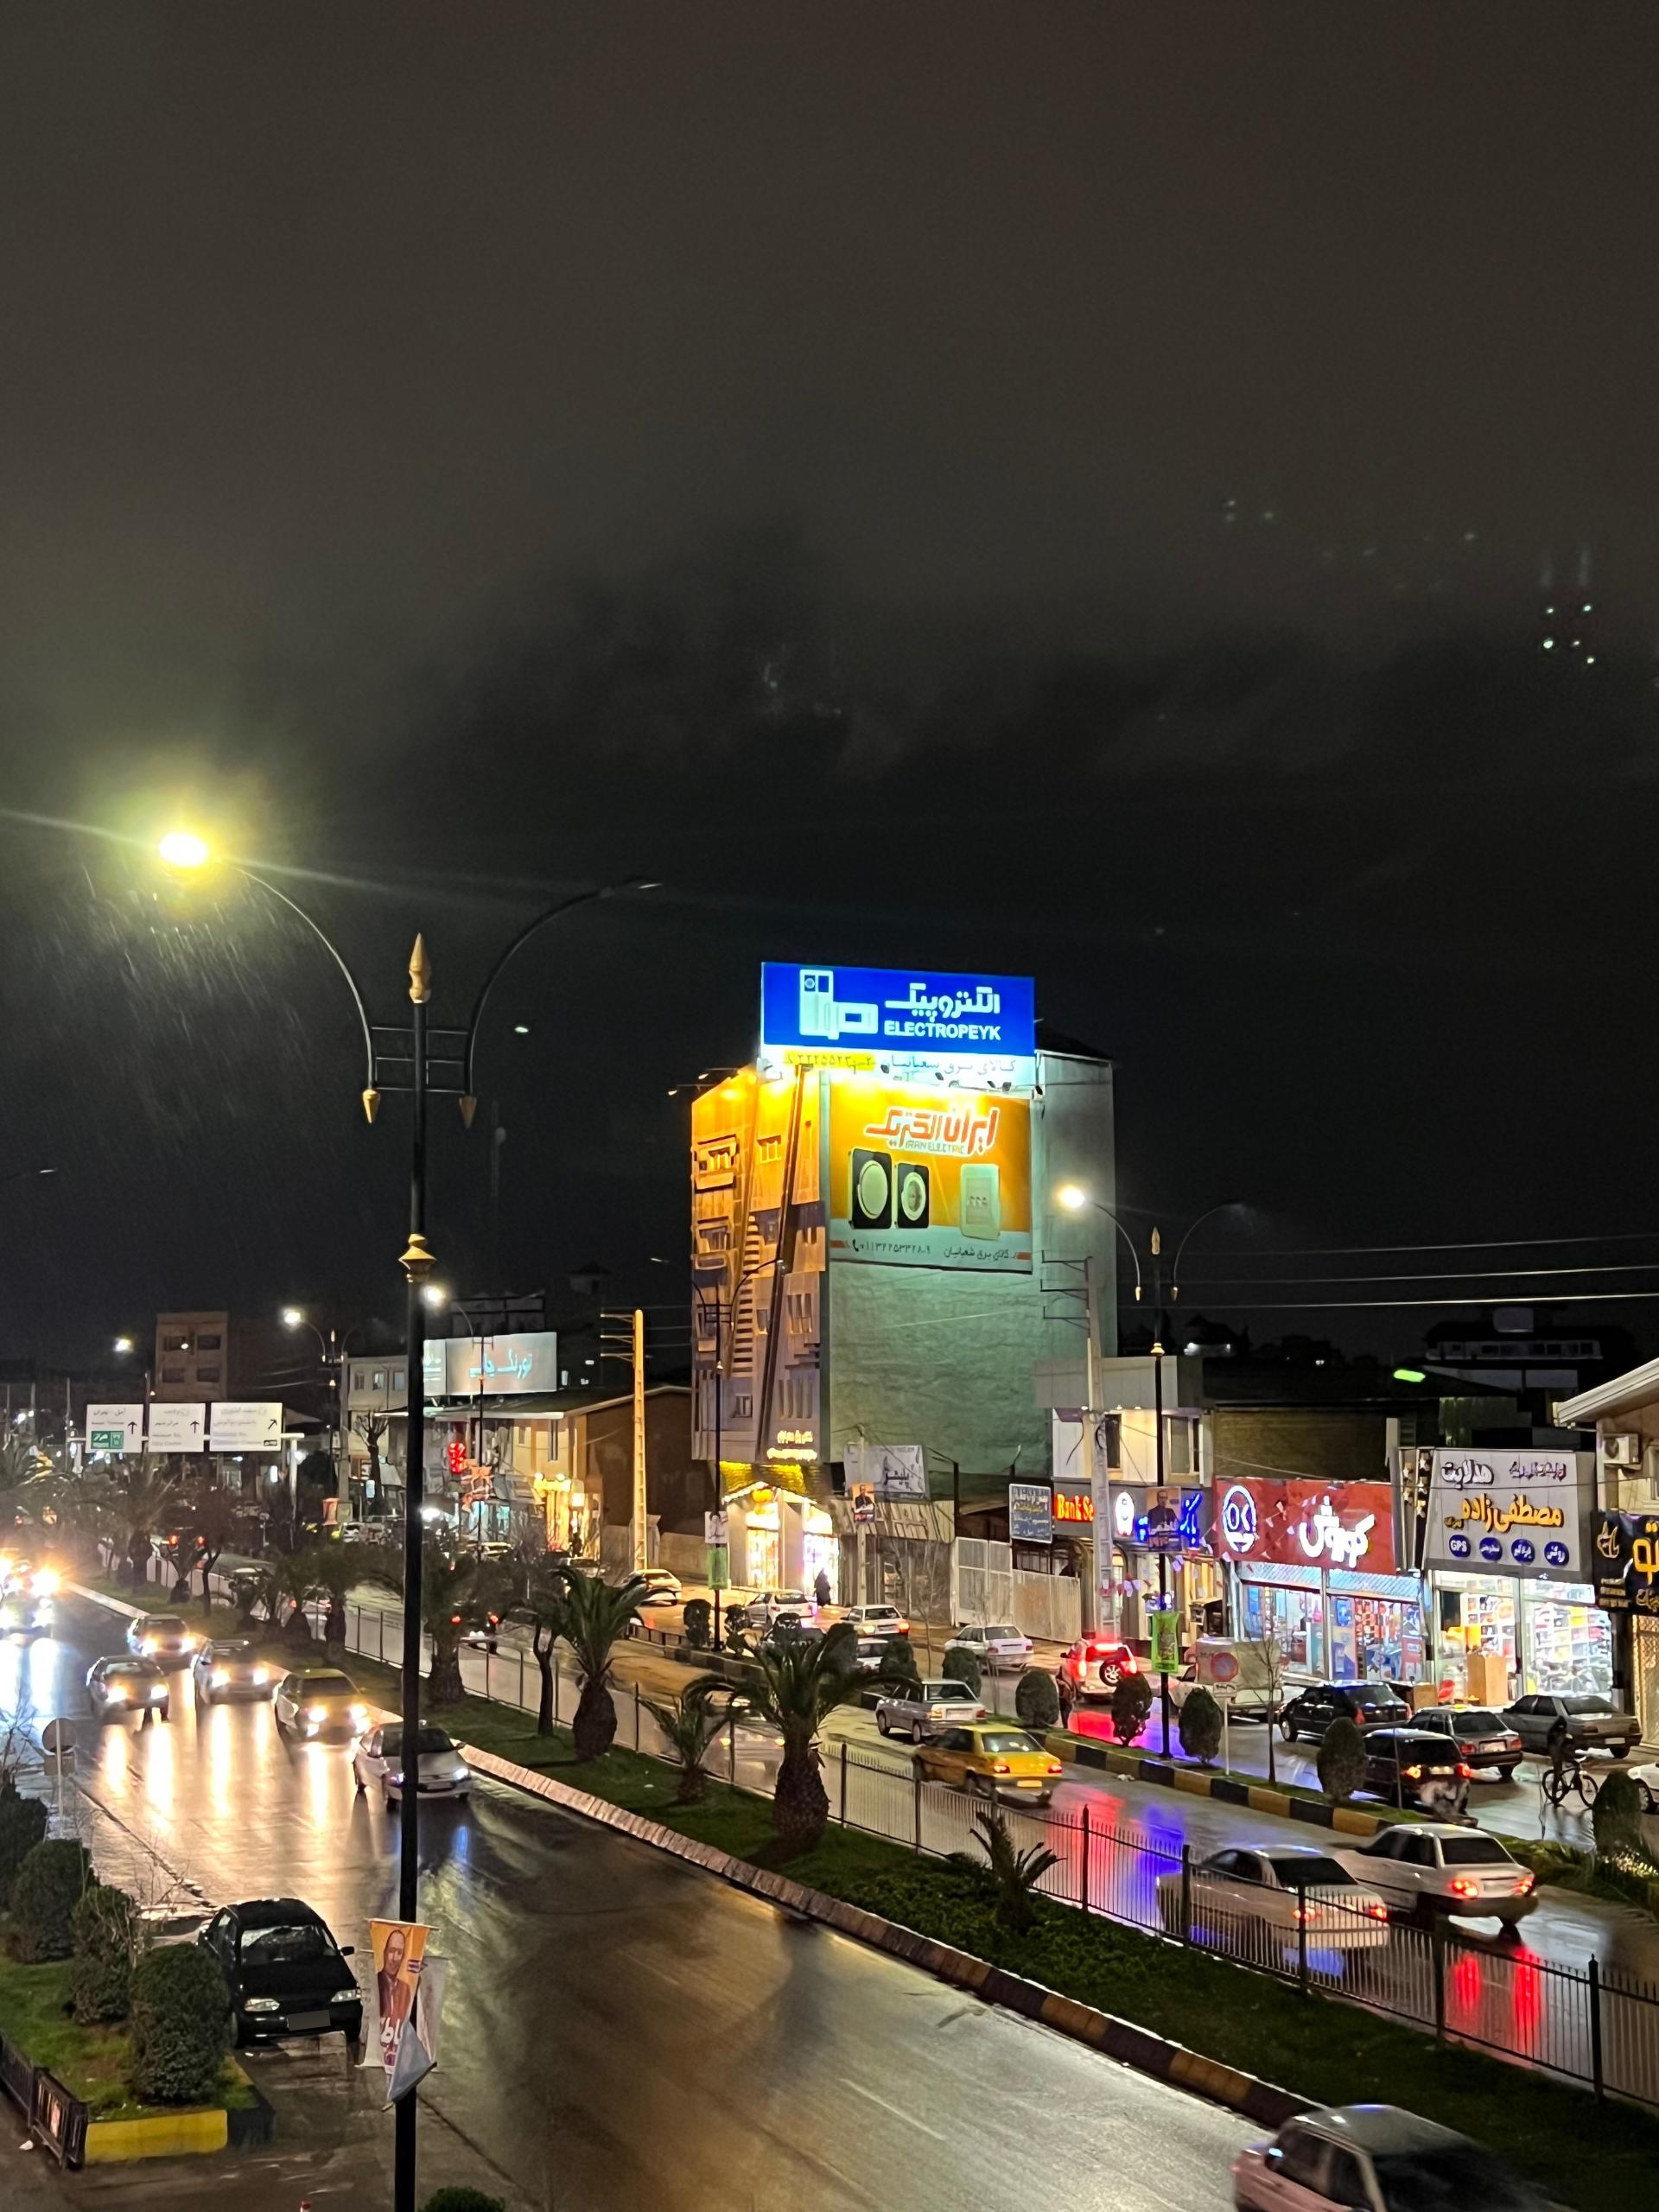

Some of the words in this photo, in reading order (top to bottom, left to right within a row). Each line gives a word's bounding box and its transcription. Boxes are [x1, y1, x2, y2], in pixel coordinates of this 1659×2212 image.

[884, 982, 1001, 1022] الکتروپیک
[884, 1020, 1001, 1040] ELECTROPEYK
[906, 1140, 927, 1150] IRAN
[927, 1141, 965, 1154] ELECTRIC
[1056, 1494, 1082, 1521] Bank
[1450, 1540, 1468, 1553] GPS
